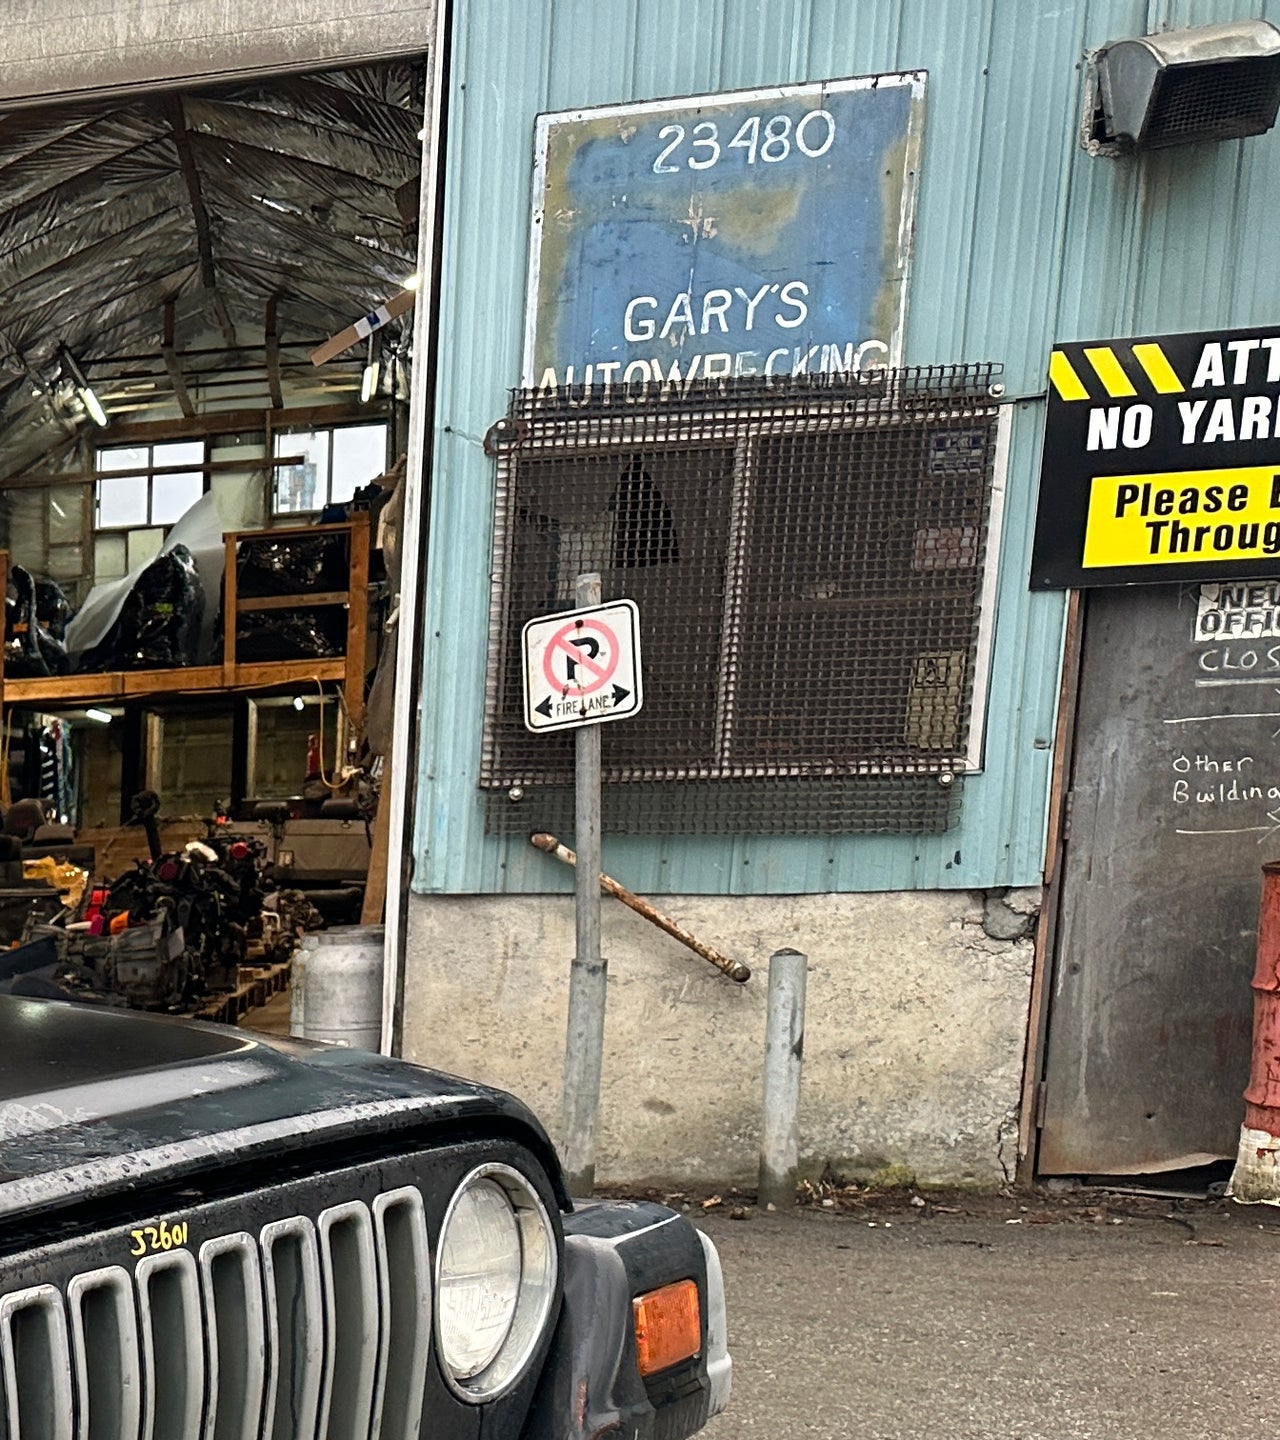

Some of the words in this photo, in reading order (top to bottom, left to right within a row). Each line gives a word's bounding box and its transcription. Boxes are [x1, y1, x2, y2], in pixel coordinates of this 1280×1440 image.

[652, 109, 837, 174] 23480
[623, 281, 809, 343] GARY'S
[1086, 403, 1154, 451] NO
[1177, 395, 1280, 445] YAR
[1114, 482, 1250, 519] Please
[1200, 610, 1280, 635] OFFI
[556, 700, 579, 717] FIRE
[130, 1222, 189, 1256] J2601
